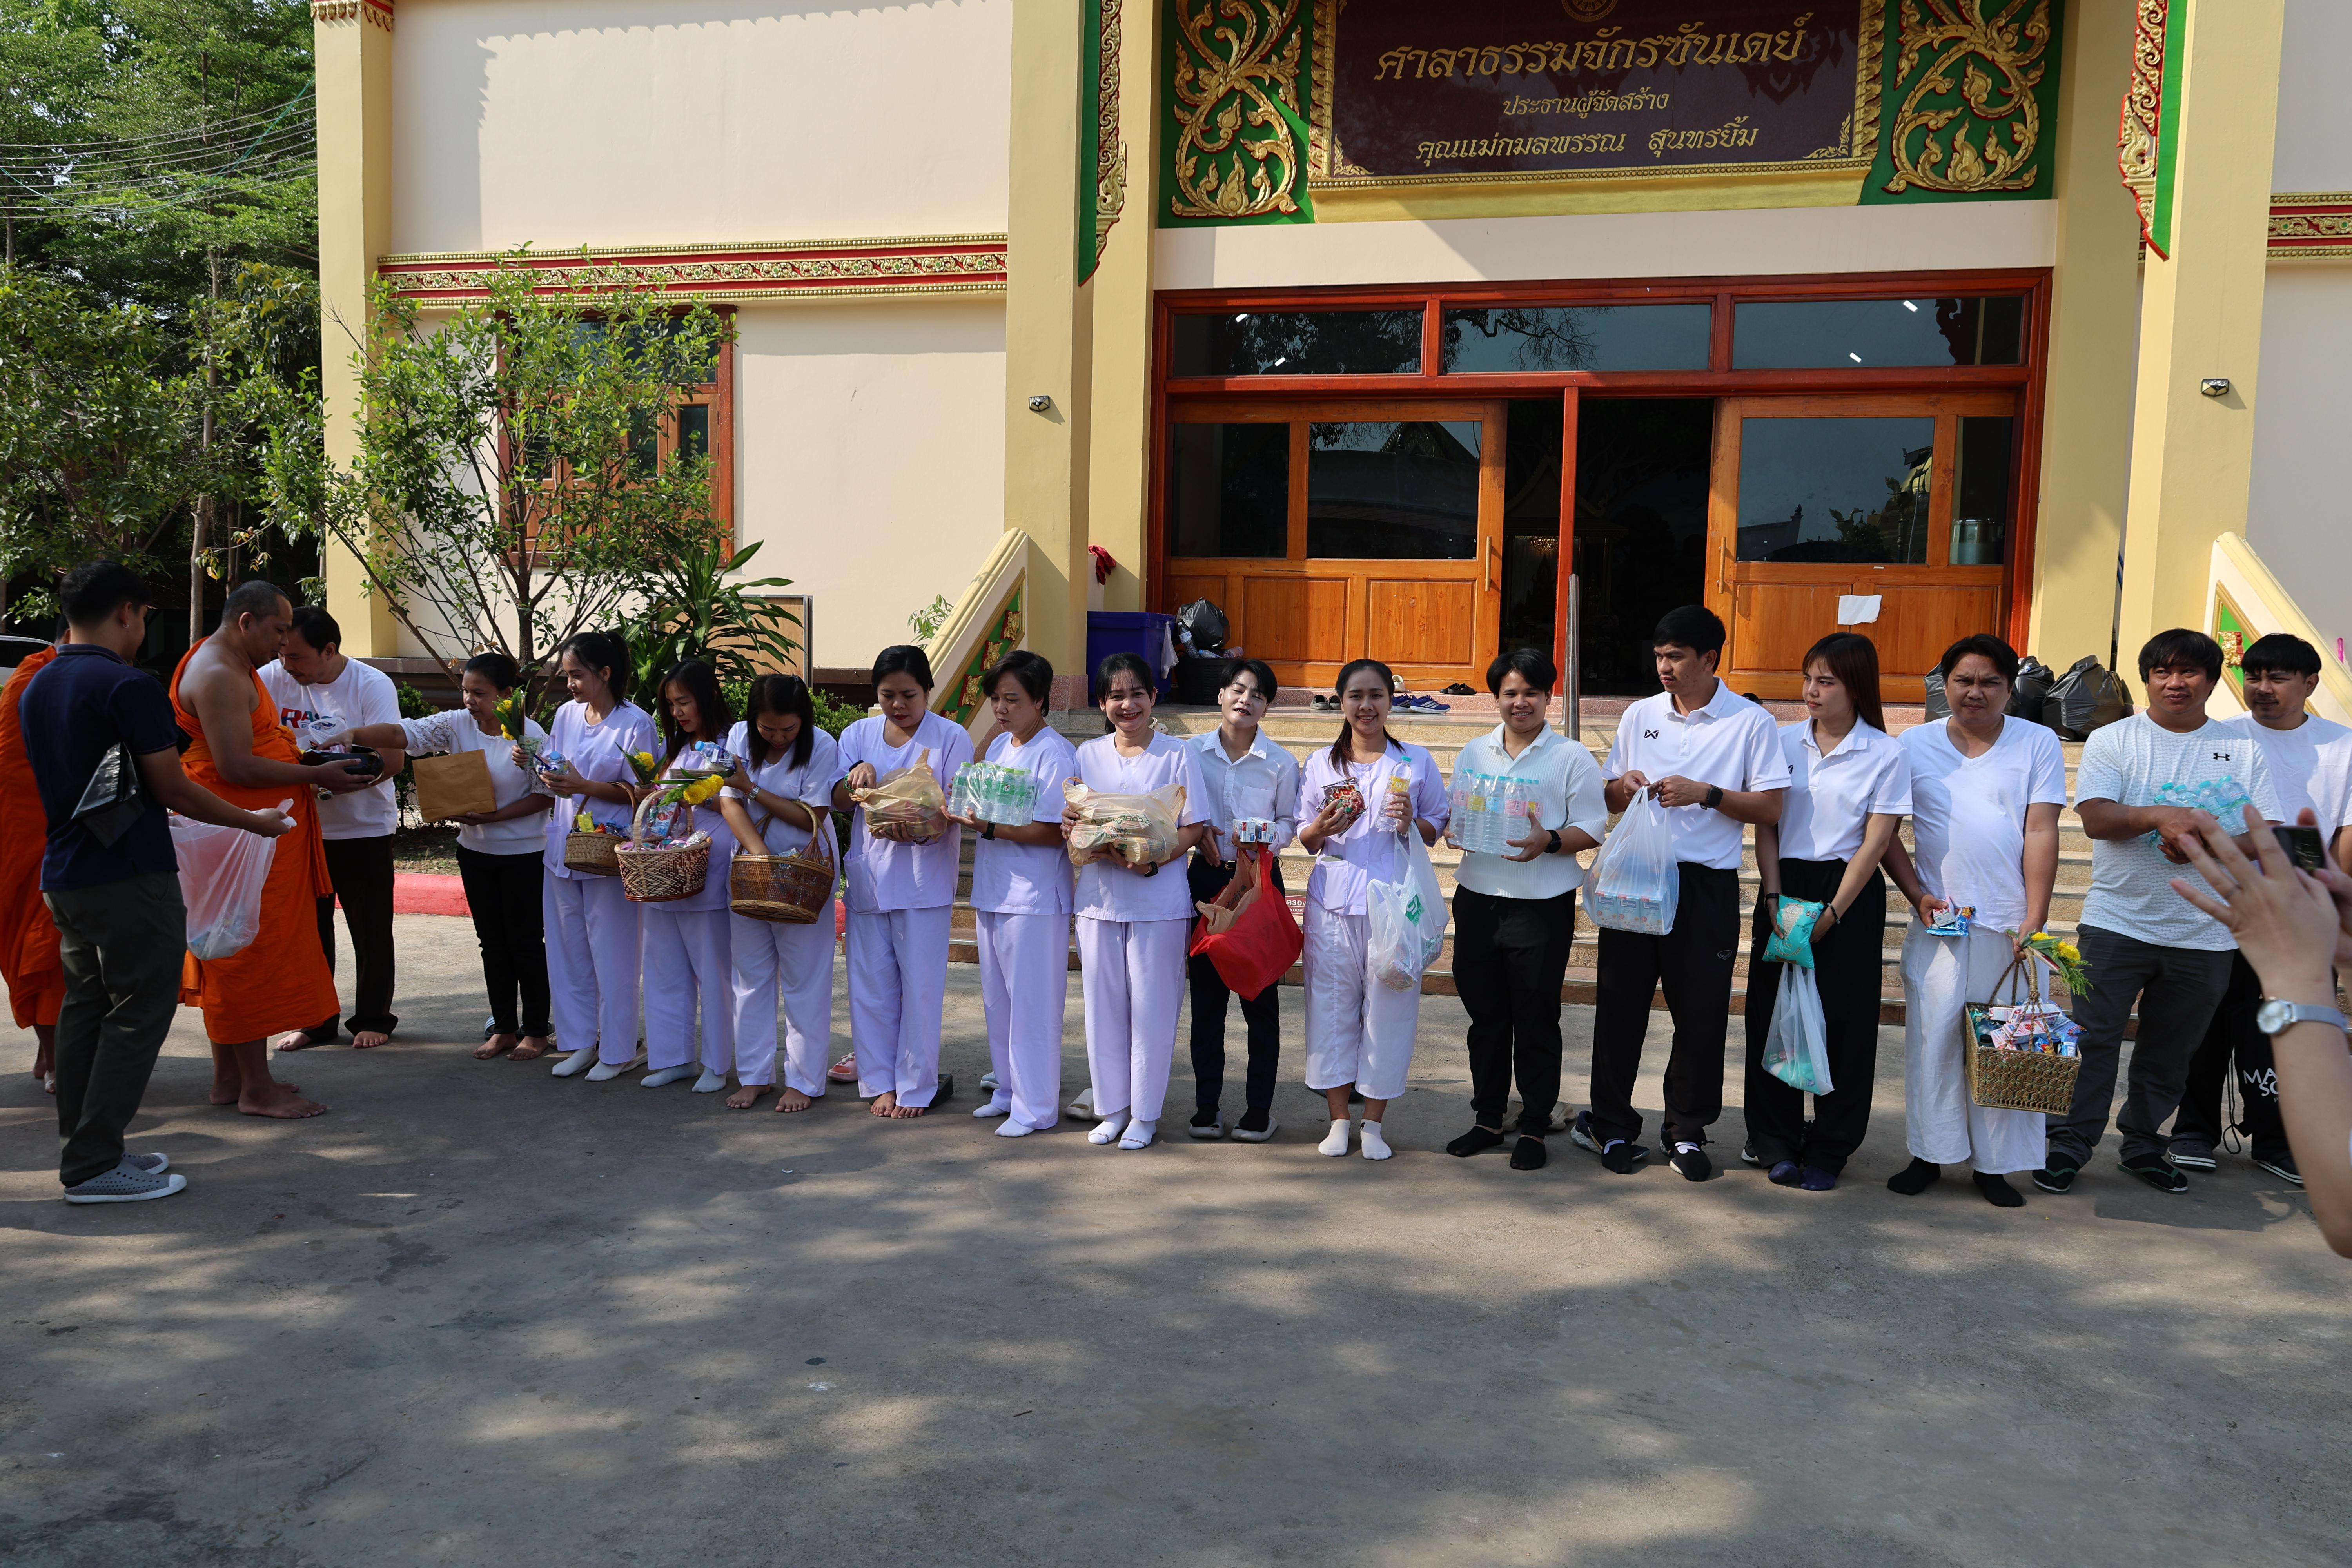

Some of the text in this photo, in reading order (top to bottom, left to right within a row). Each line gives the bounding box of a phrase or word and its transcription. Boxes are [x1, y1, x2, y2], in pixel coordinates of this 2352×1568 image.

[1503, 86, 1670, 119] ประธานผู้จัดสร้าง
[1416, 132, 1627, 167] คุณแม่กมลพรรณ
